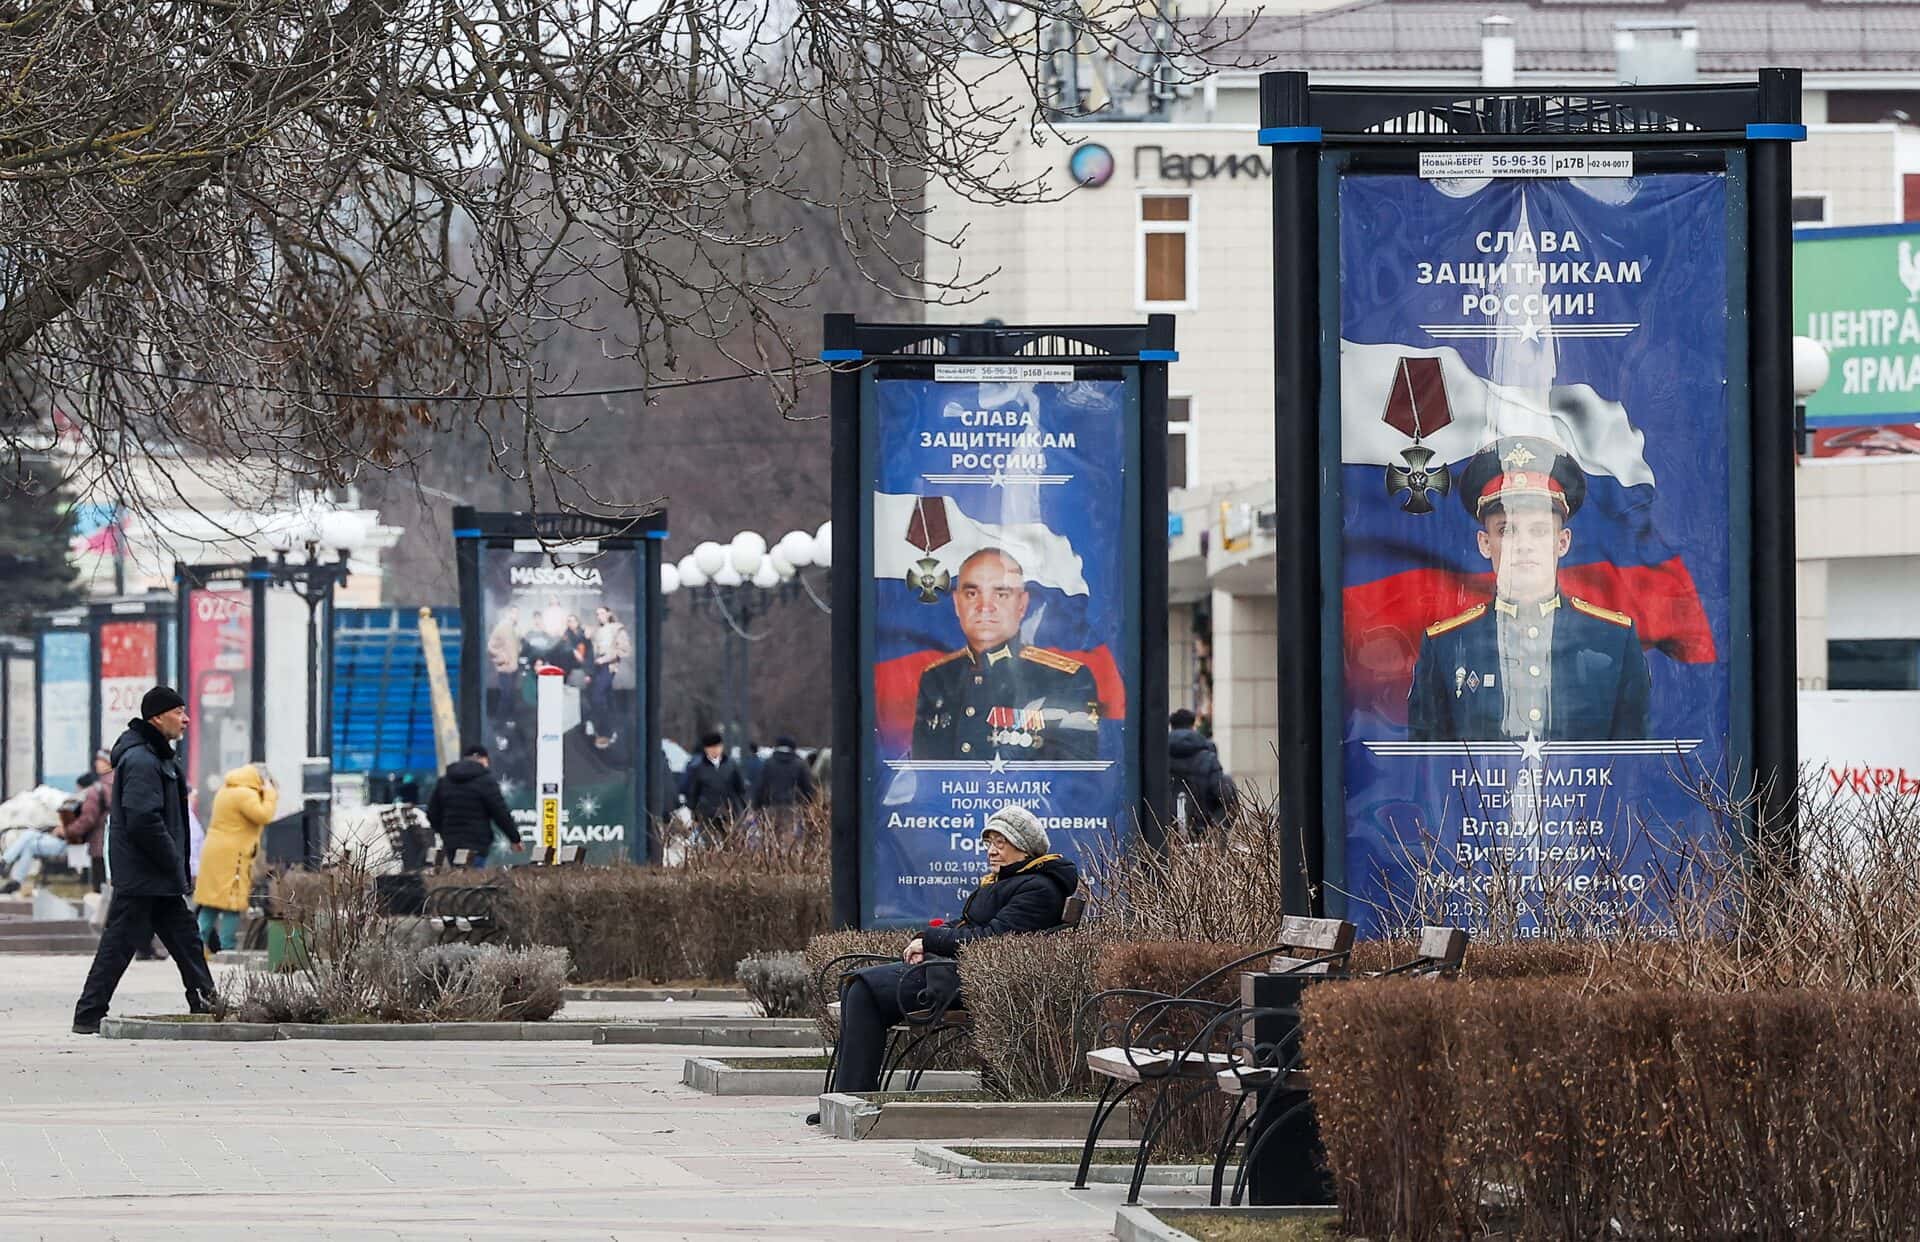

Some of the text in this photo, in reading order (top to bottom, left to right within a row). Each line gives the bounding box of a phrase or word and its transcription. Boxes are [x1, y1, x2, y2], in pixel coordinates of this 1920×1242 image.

[1492, 155, 1546, 166] 56-96-36
[1475, 230, 1581, 253] СЛАВА
[1416, 260, 1643, 289] ЗАЩИТНИКАМ
[1462, 292, 1595, 316] РОССИИ!
[961, 411, 1034, 427] СЛАВА
[920, 431, 1076, 450] ЗАЩИТНИКАМ
[951, 453, 1047, 469] РОССИИ!
[1451, 768, 1613, 787] НАШ ЗЕМЛЯК
[942, 781, 1051, 794] НАШ ЗЕМЛЯК
[952, 798, 1040, 810] ПОЛКОВНИК
[1478, 790, 1587, 809] ЛЕЙТЕНАНТ
[887, 811, 975, 829] Алексей
[1462, 817, 1604, 838] Владислав
[898, 874, 968, 888] награжден
